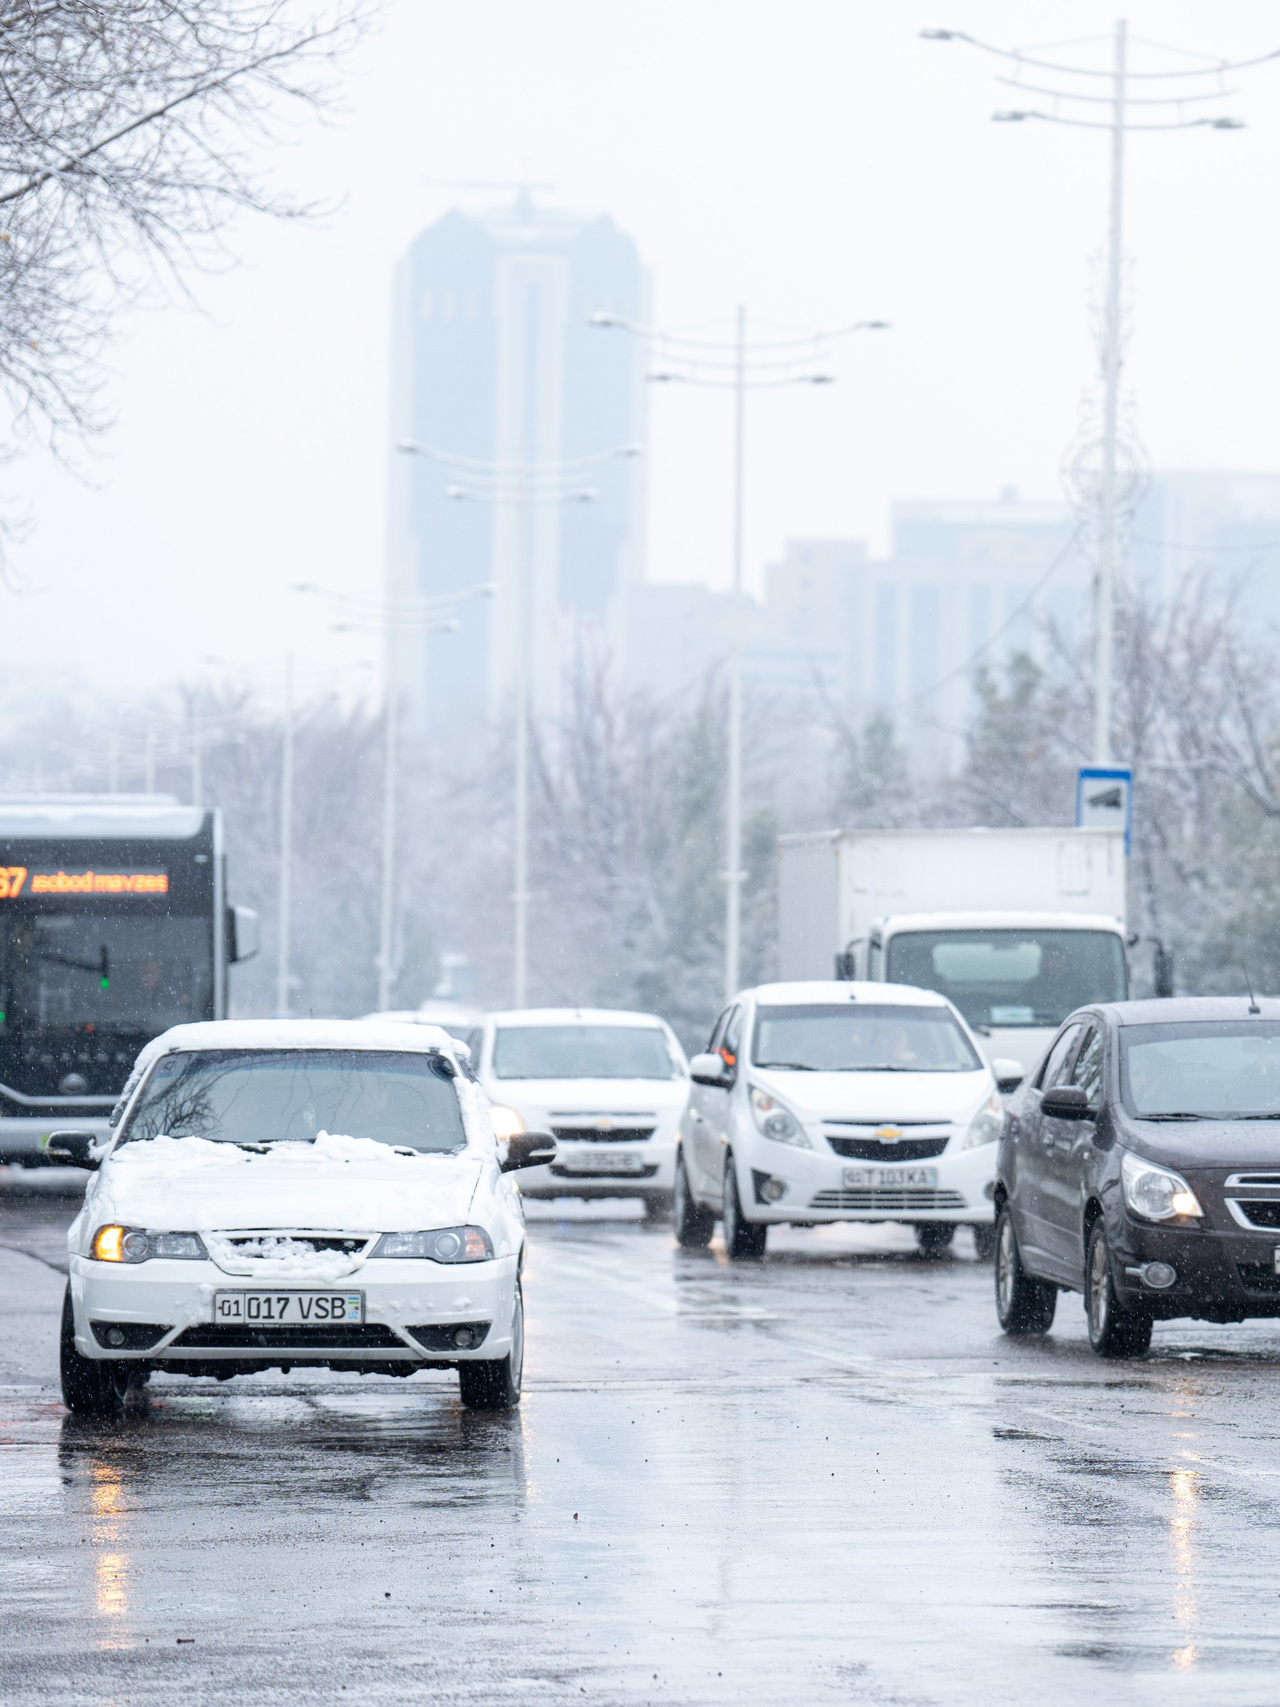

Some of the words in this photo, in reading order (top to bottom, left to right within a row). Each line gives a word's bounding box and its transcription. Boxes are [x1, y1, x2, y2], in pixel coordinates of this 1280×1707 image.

[221, 1299, 242, 1317] 01
[247, 1296, 290, 1320] 017
[298, 1296, 346, 1320] VSB
[348, 1311, 359, 1320] UZ
